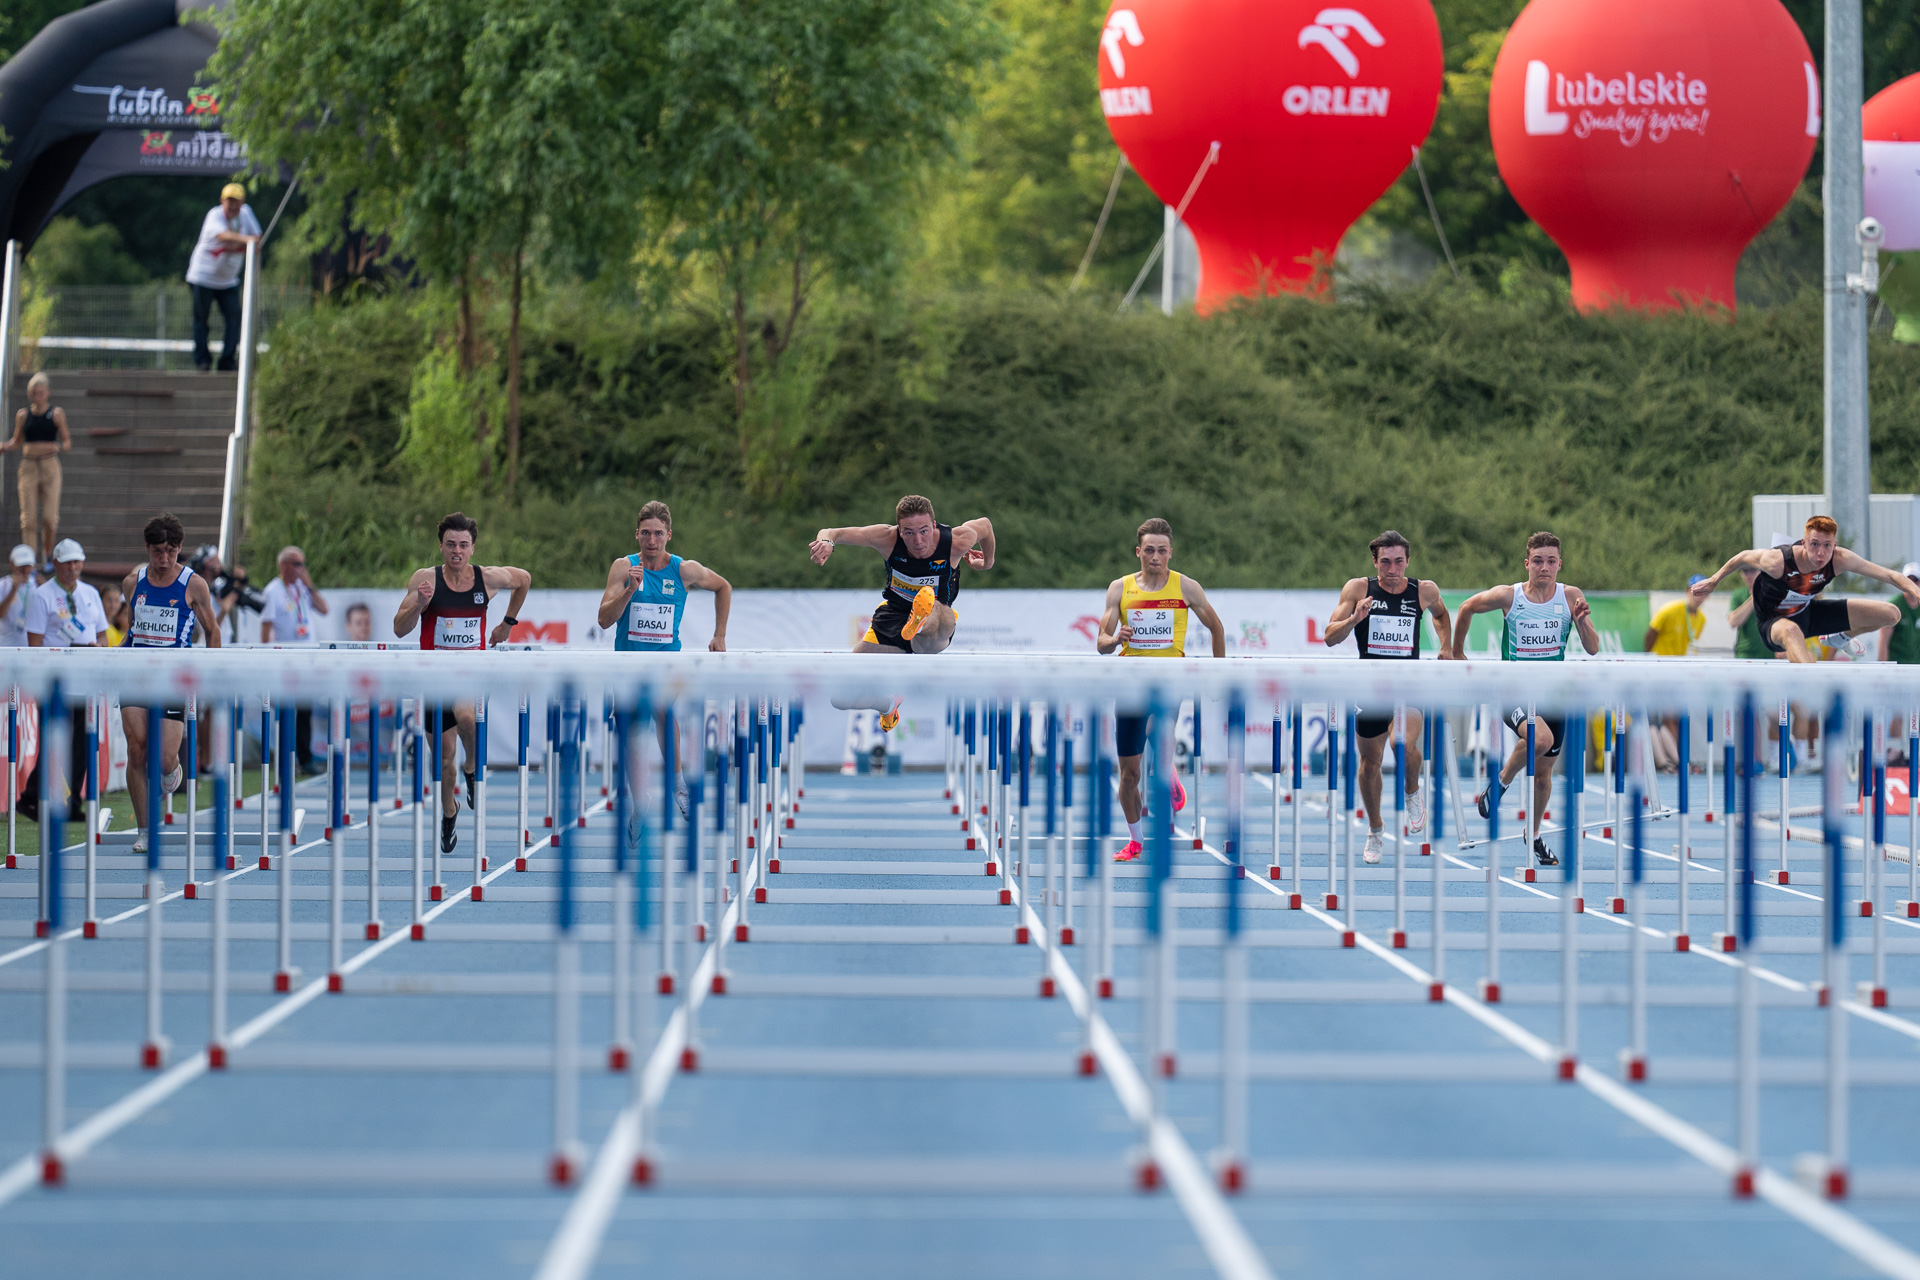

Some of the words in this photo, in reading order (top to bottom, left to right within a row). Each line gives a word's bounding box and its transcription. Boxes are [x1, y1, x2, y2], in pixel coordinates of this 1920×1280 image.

[1281, 85, 1390, 117] ORLEN
[159, 608, 175, 618] 293
[658, 606, 672, 615] 174
[1155, 611, 1166, 620] 25
[135, 621, 174, 633] MEHLICH
[464, 619, 478, 628] 187
[637, 619, 667, 630] BASAJ
[1397, 618, 1412, 627] 198
[1544, 620, 1559, 629] 130
[442, 633, 475, 644] WITOS
[1372, 631, 1410, 643] BABULA
[1521, 634, 1557, 645] SEKUŁA
[1511, 710, 1521, 723] 2
[1307, 716, 1326, 752] 2
